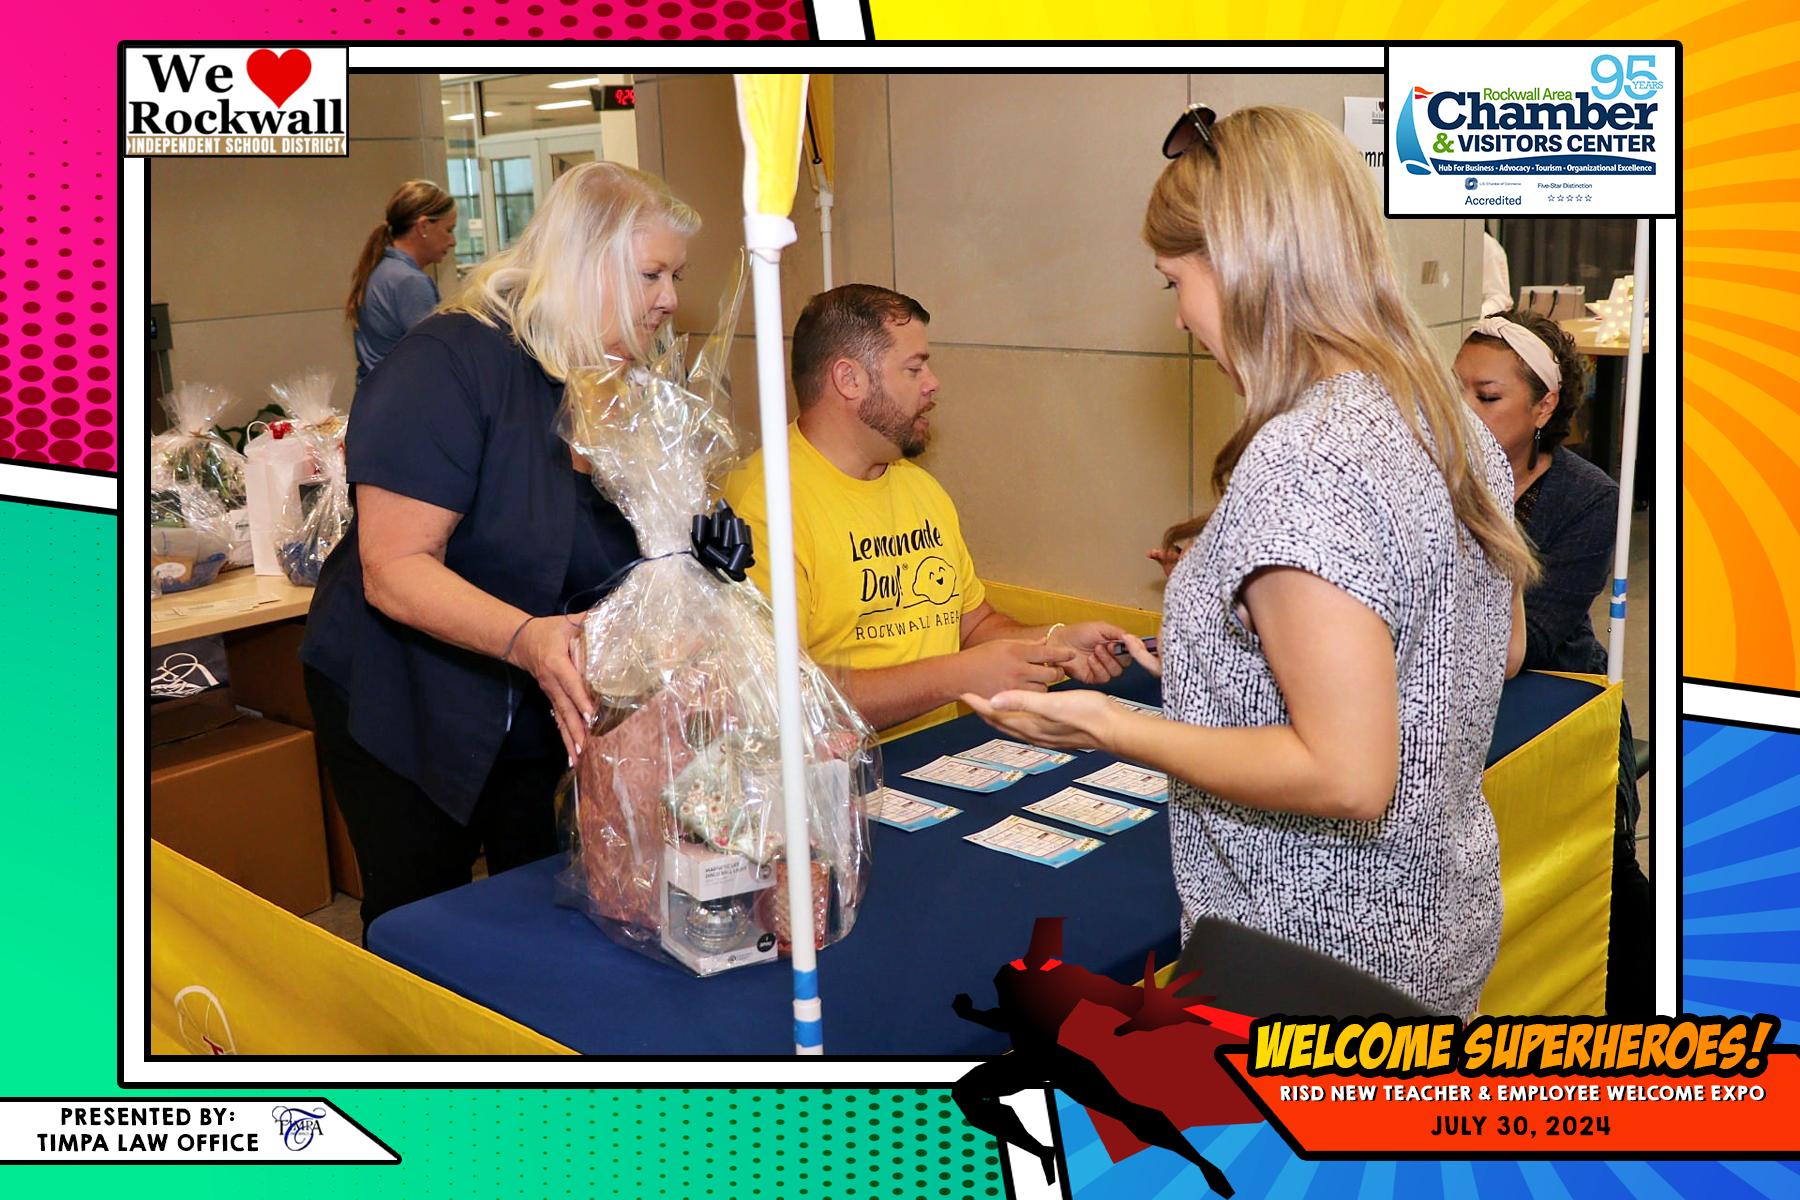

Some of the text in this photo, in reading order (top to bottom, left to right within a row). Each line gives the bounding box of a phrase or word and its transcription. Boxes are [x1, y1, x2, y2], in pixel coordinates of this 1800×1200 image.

[849, 519, 943, 562] Lemonade
[856, 610, 960, 640] ROCKWALL AREA
